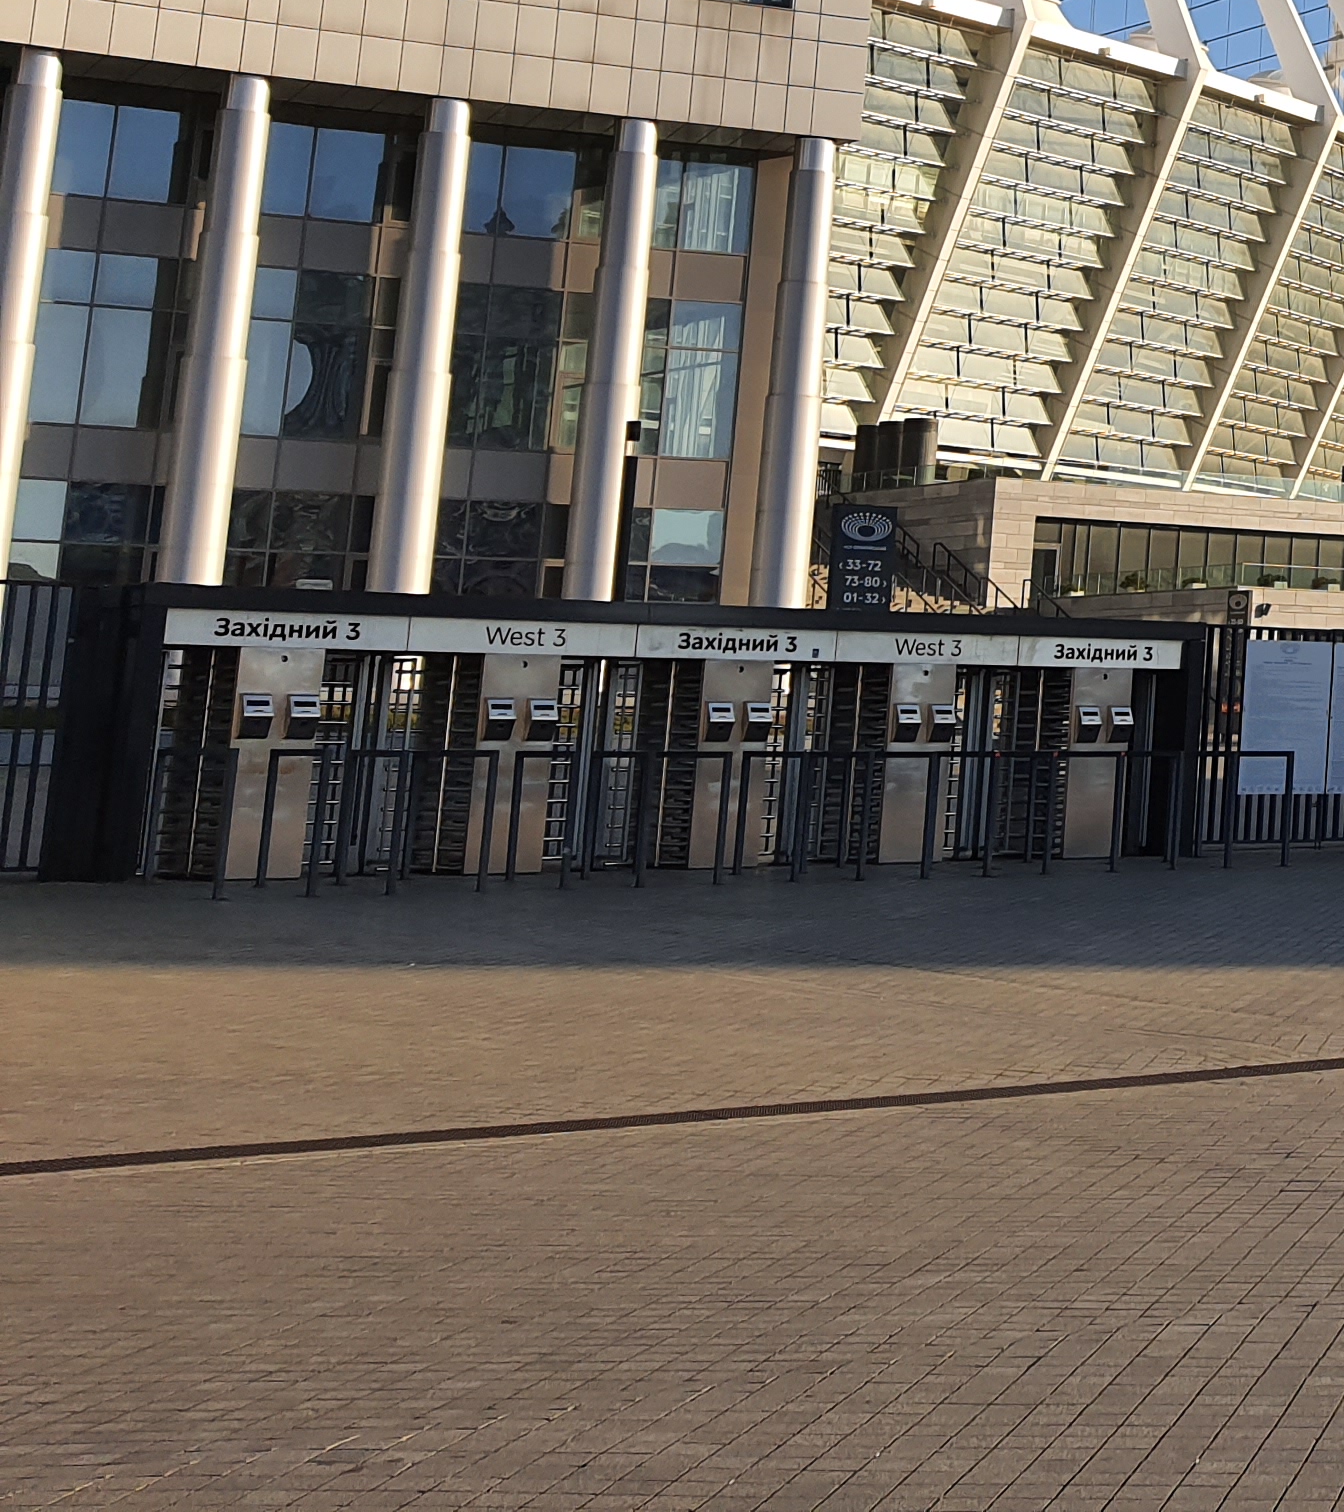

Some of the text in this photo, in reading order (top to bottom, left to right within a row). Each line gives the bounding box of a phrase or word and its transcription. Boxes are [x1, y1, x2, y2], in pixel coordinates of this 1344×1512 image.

[845, 559, 882, 571] 33-72
[844, 575, 880, 587] 73-80
[843, 592, 879, 604] 01-32
[213, 617, 361, 641] Західний 3
[485, 626, 567, 647] West 3
[677, 632, 798, 654] Західний 3
[894, 638, 962, 657] West 3
[1053, 643, 1154, 662] Західний 3
